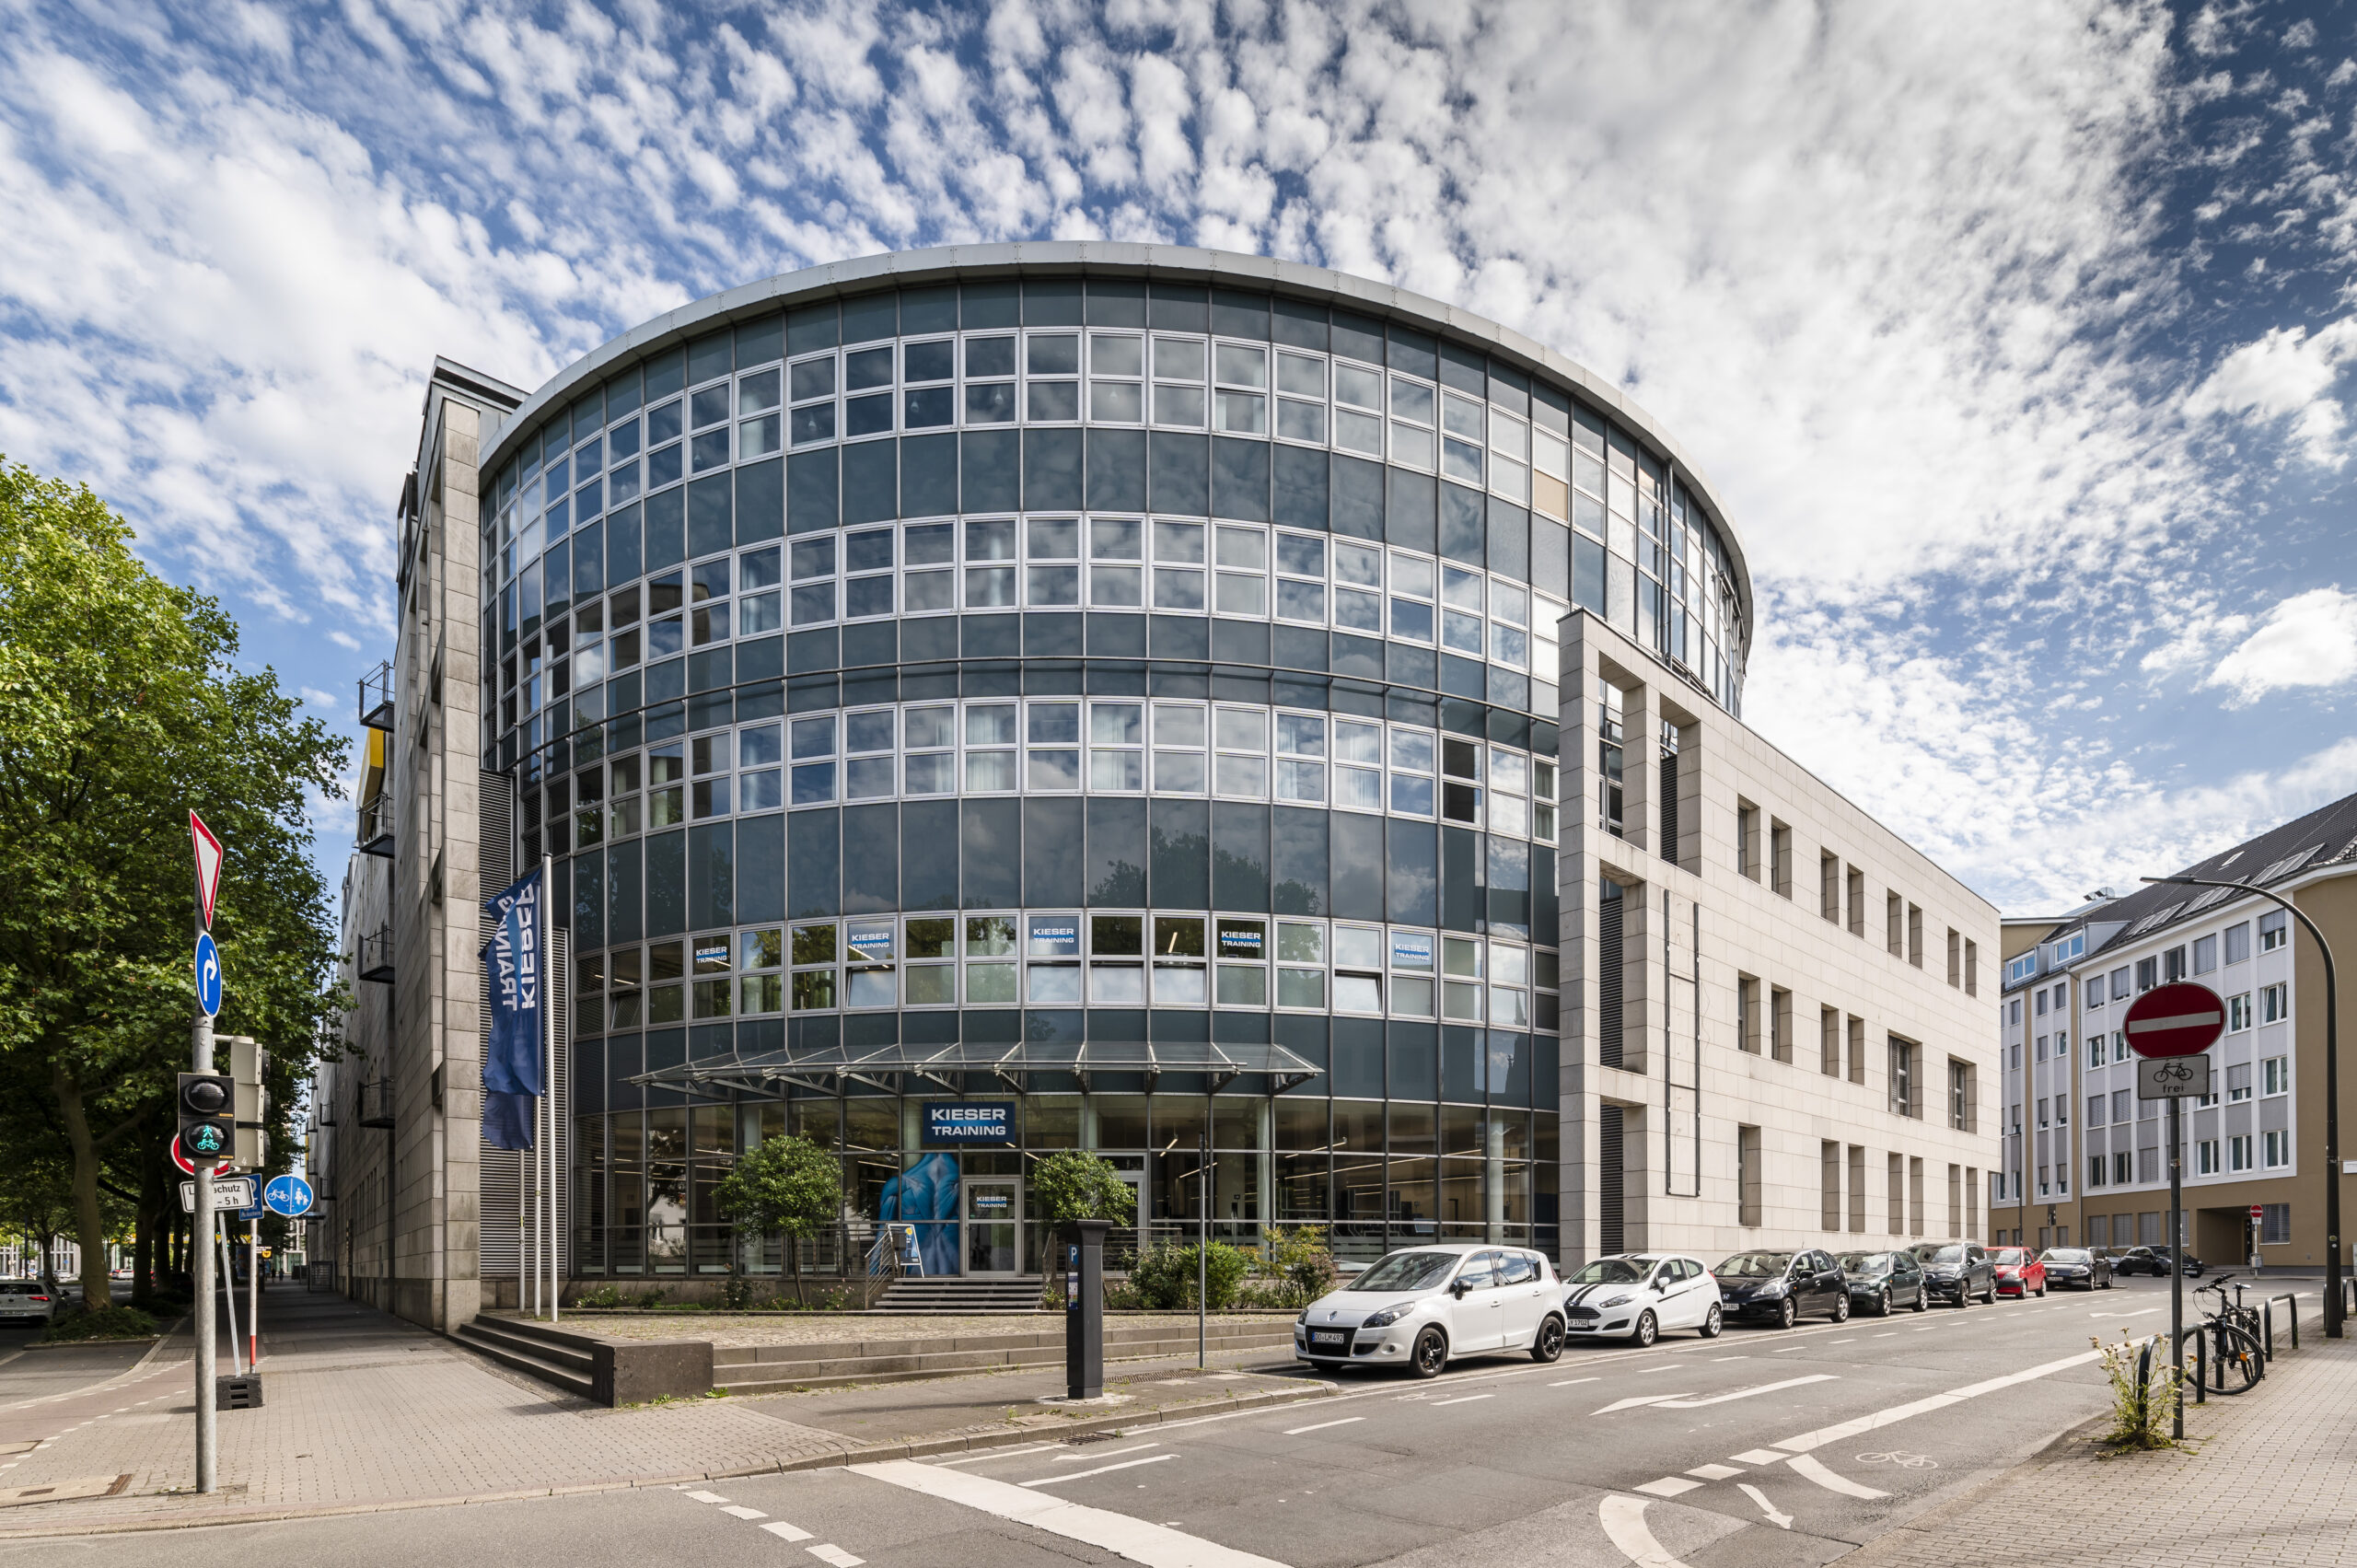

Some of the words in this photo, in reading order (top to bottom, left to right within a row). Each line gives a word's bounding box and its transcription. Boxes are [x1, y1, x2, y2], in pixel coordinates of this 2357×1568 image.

[1033, 927, 1074, 935] KIESER
[1221, 931, 1261, 940] KIESER
[851, 933, 889, 942] KIESER
[1221, 940, 1261, 948] TRAINING
[1395, 944, 1429, 953] KIESER
[695, 947, 727, 957] KIESER
[2163, 1083, 2184, 1094] frei
[932, 1109, 1006, 1121] KIESER
[932, 1126, 1006, 1135] TRAINING
[188, 1184, 241, 1195] Lschutz
[225, 1196, 231, 1205] 5
[232, 1196, 239, 1205] h
[1071, 1247, 1078, 1261] P
